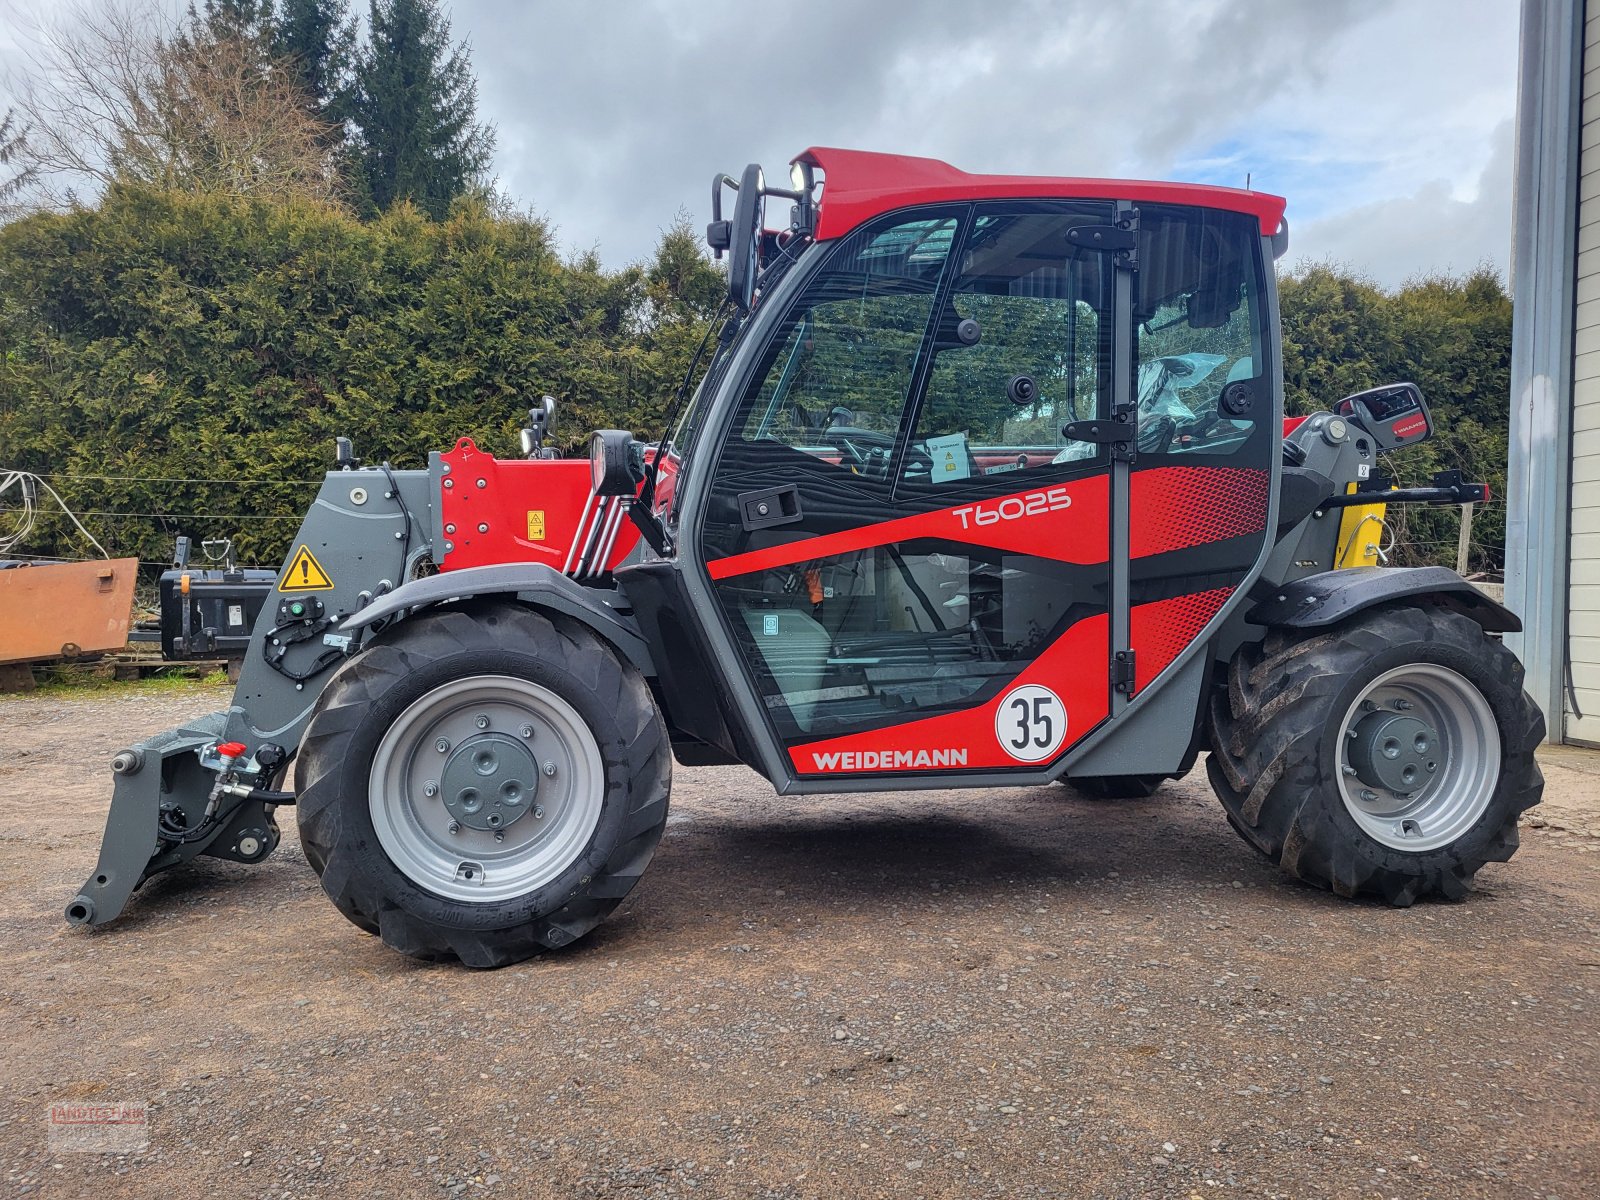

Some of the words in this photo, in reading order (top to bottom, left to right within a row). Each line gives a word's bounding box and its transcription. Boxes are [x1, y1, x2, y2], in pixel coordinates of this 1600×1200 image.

[952, 488, 1072, 530] T6025
[1010, 696, 1053, 750] 35
[812, 748, 968, 770] WEIDEMANN
